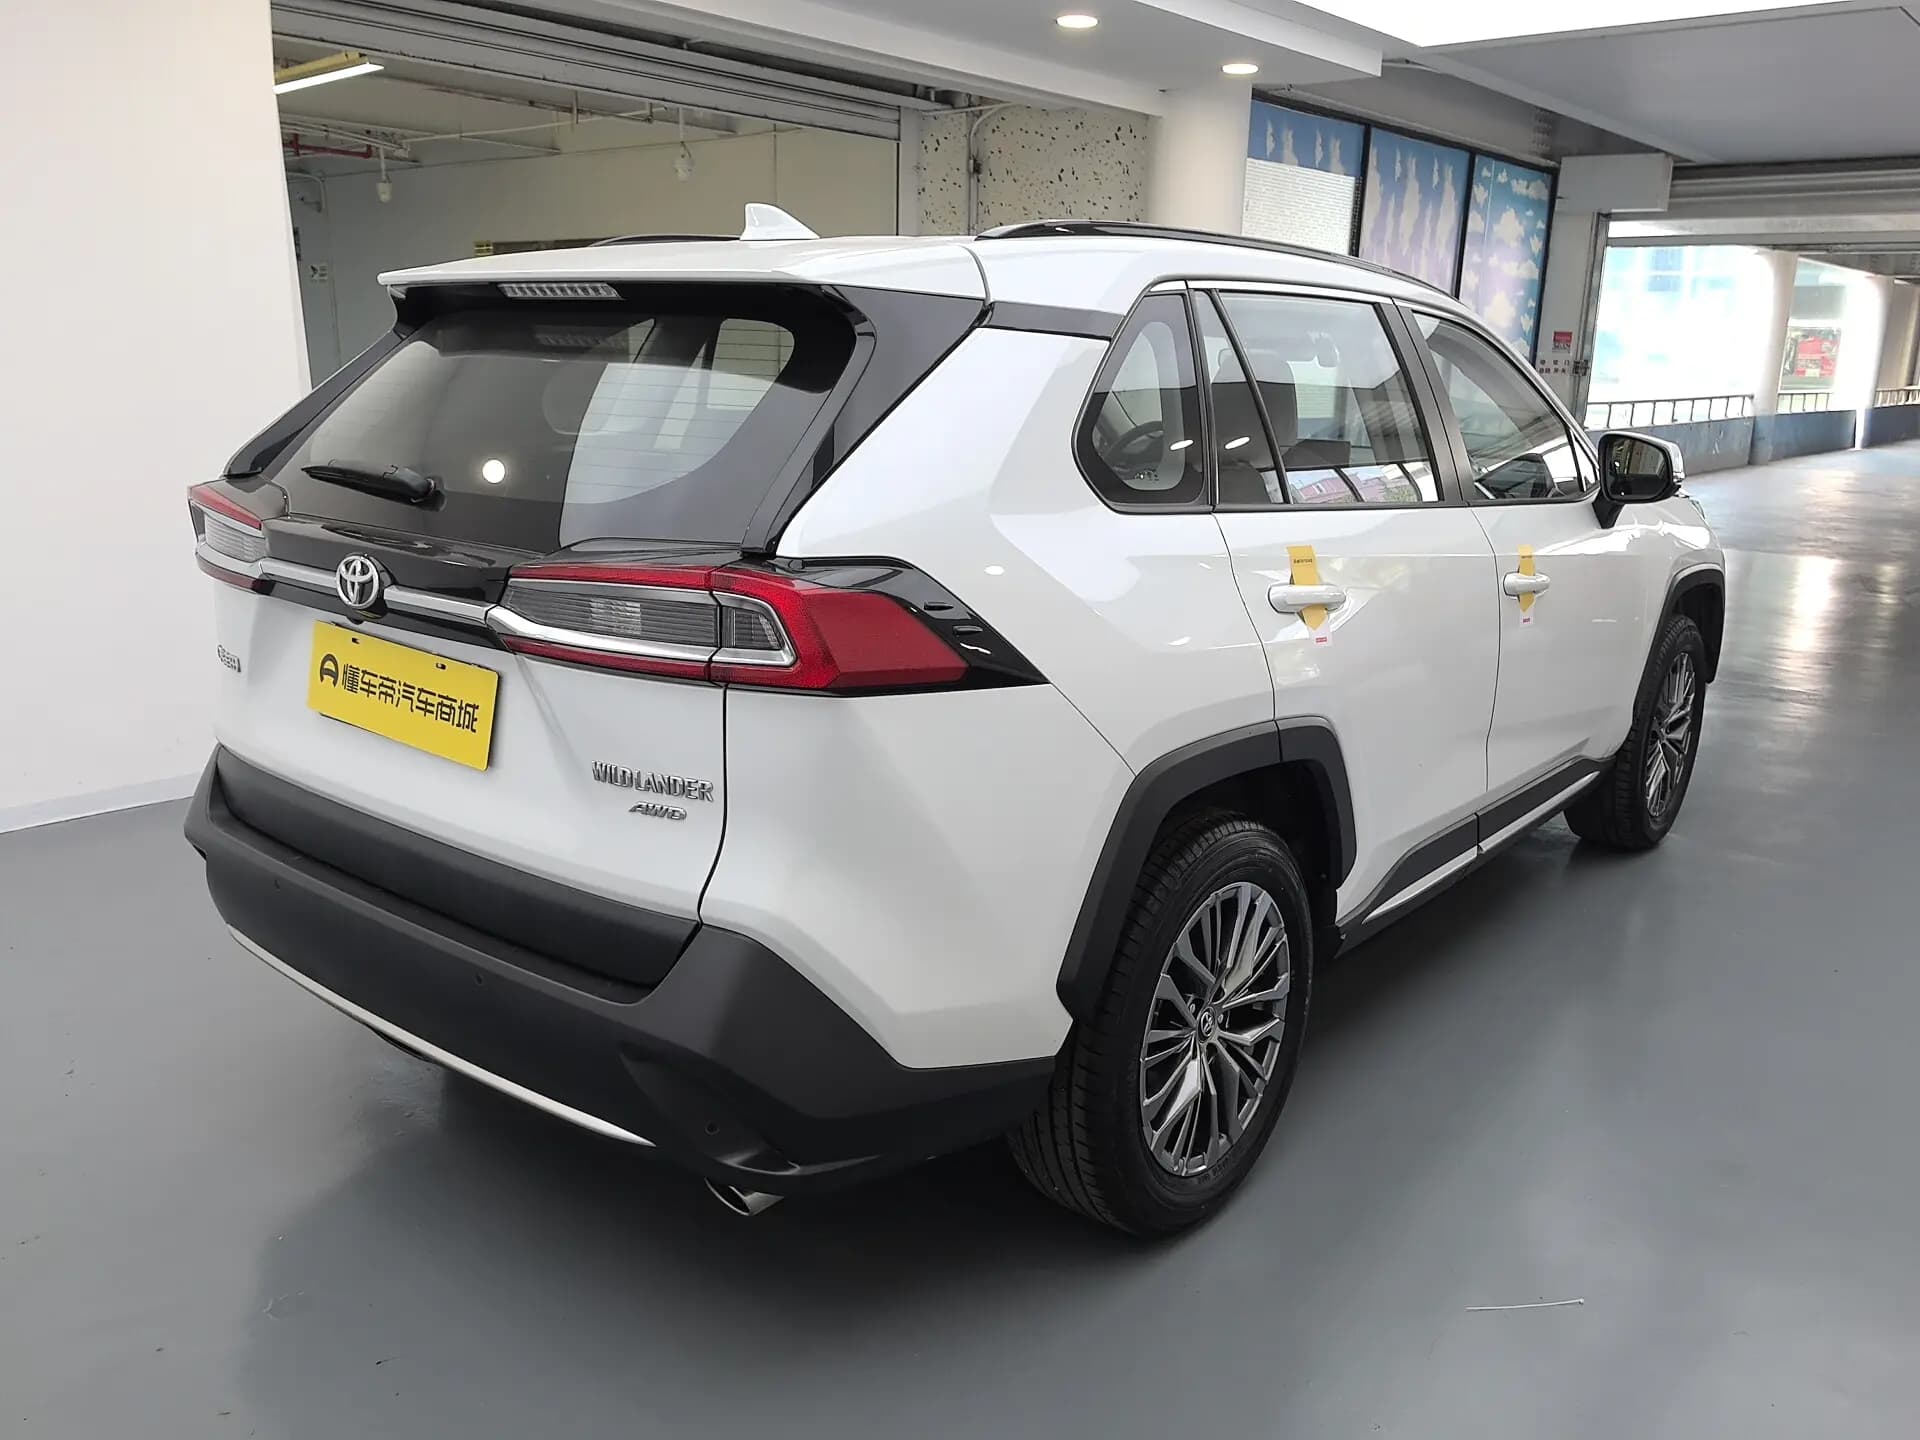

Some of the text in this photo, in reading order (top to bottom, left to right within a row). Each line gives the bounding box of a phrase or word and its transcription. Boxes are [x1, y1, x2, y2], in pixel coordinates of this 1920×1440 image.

[342, 663, 480, 734] 懂车帝汽车商城
[592, 760, 714, 802] WILDLANDER
[628, 801, 688, 821] AWD
